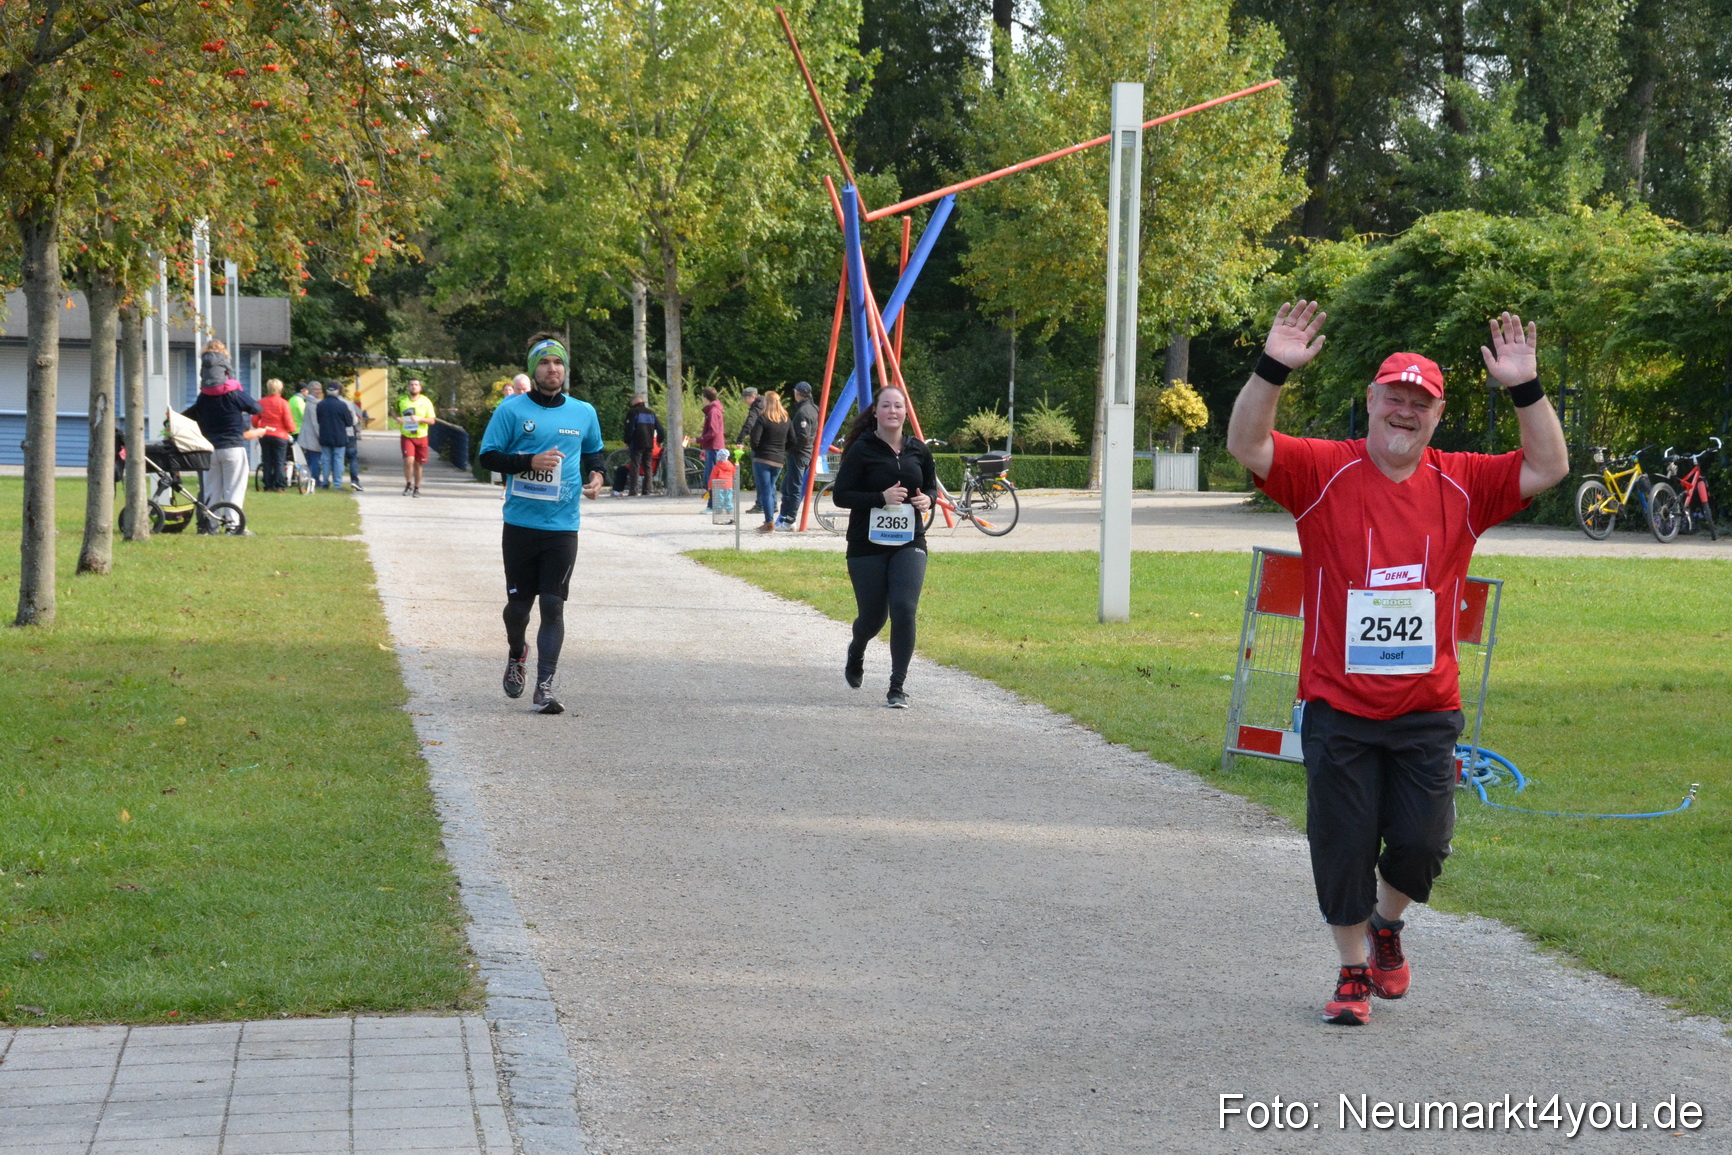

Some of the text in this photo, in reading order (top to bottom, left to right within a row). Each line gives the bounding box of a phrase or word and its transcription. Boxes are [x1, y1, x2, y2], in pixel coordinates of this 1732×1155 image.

[558, 428, 580, 436] BOCK
[520, 469, 554, 483] 2066
[876, 516, 908, 529] 2363
[1385, 570, 1409, 581] DEHN
[1360, 616, 1423, 641] 2542
[1380, 650, 1405, 660] Josef
